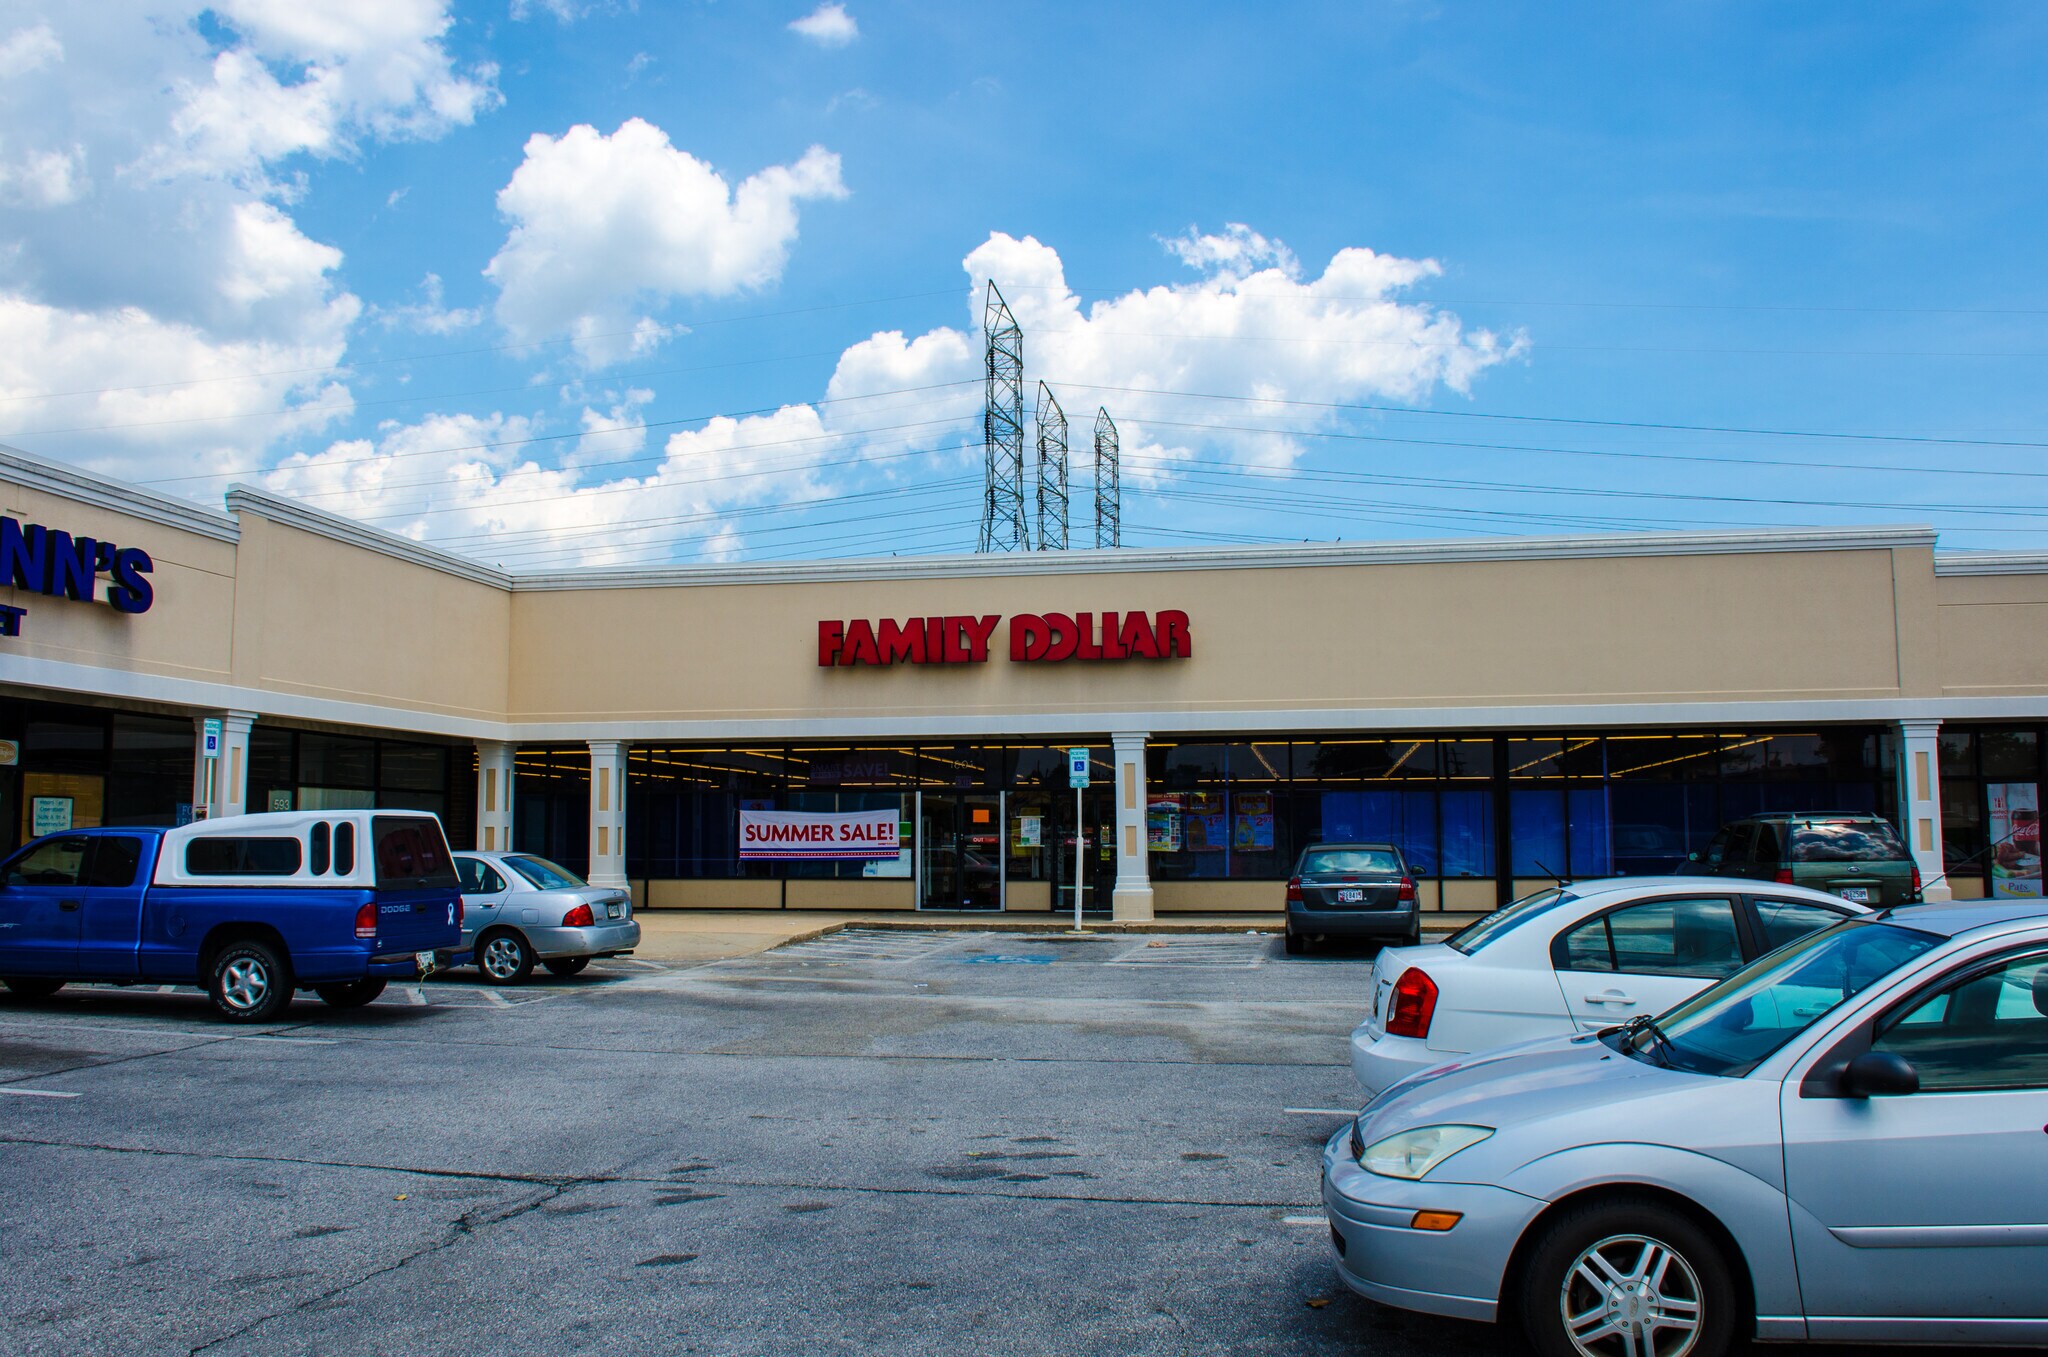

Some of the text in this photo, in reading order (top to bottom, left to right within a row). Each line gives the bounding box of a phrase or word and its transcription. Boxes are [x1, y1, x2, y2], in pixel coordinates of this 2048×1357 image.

[818, 609, 1192, 667] FAMILY DOLLAR
[843, 762, 889, 778] SAVE!
[273, 799, 289, 810] 593
[745, 823, 894, 842] SUMMER SALE!
[381, 904, 411, 913] DODGE
